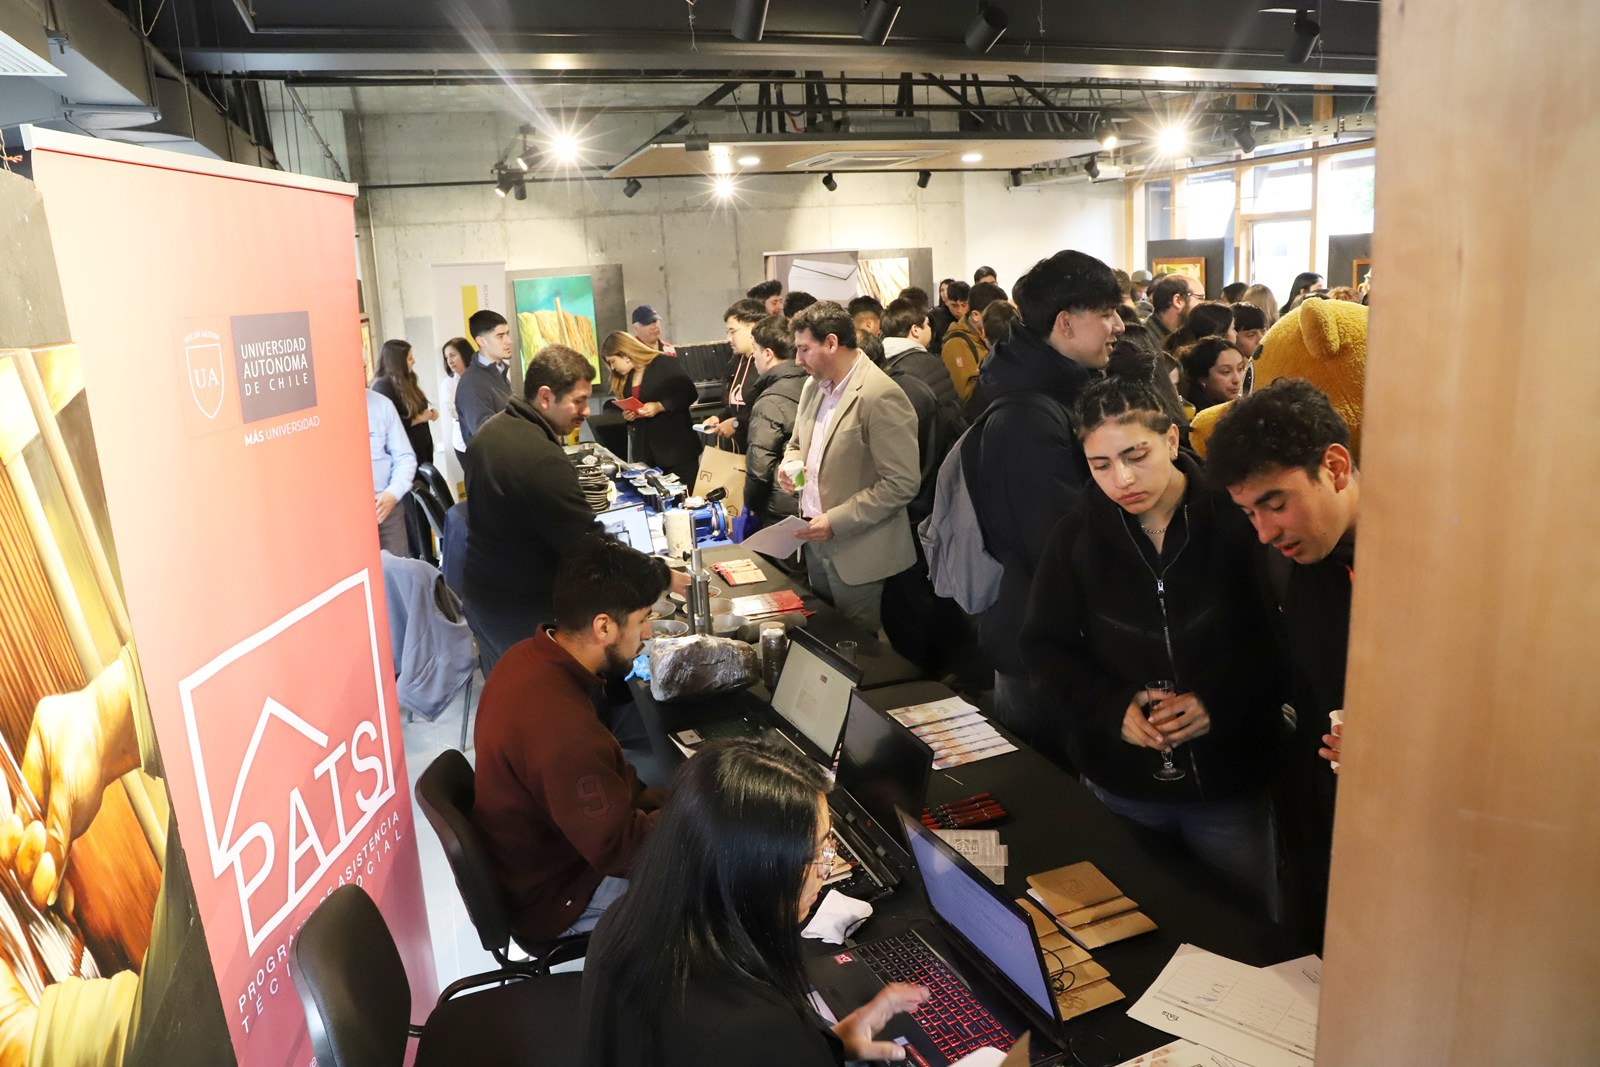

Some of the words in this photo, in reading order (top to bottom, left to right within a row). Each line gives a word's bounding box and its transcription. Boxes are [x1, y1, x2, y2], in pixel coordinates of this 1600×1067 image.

[241, 337, 306, 360] UNIVERSIDAD
[194, 368, 220, 389] UA
[244, 353, 308, 379] AUTONOMA
[245, 381, 260, 396] DE
[269, 372, 308, 391] CHILE
[244, 429, 264, 446] MÁS
[265, 416, 320, 440] UNIVERSIDAD
[229, 720, 391, 958] PATS
[338, 811, 400, 888] ASISTENCIA
[355, 829, 402, 888] OCIAL
